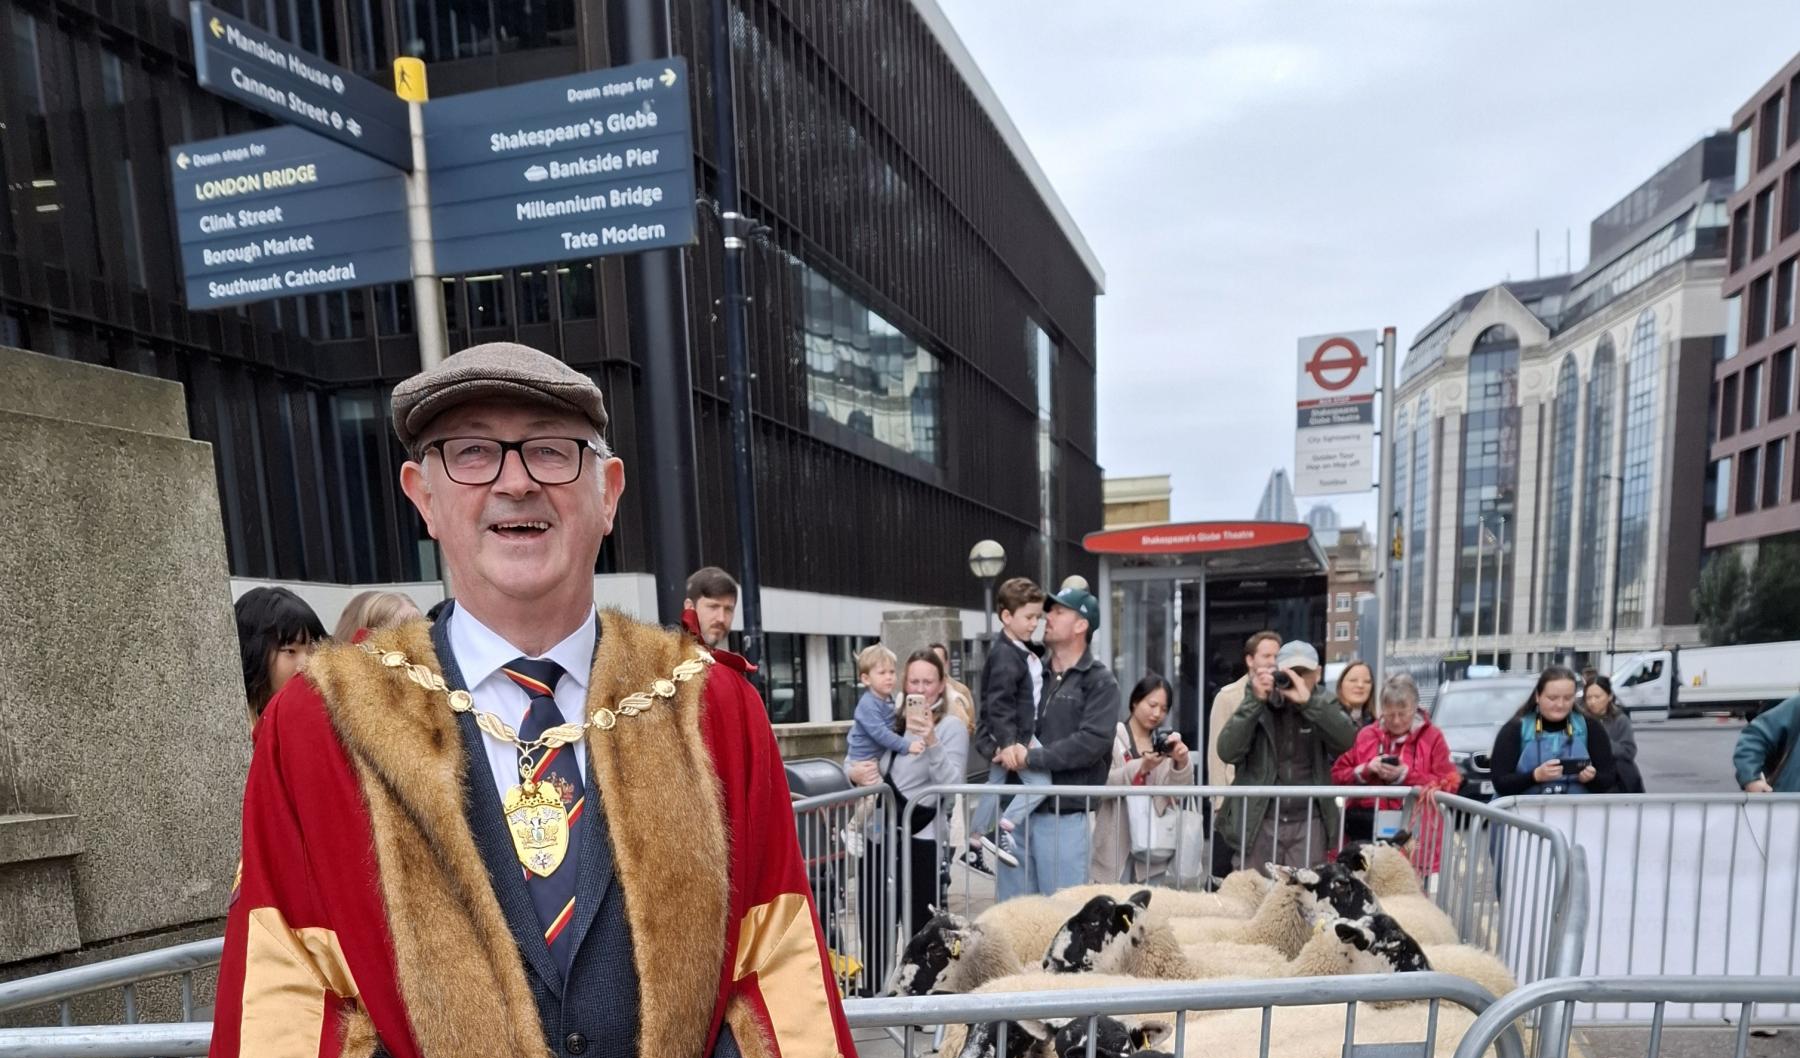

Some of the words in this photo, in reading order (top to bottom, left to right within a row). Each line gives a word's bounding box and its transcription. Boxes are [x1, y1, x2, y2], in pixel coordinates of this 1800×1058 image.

[226, 24, 288, 69] Mansion
[288, 54, 332, 90] House
[231, 66, 287, 106] Cannon
[288, 91, 330, 126] Street
[567, 87, 600, 103] Down
[602, 80, 635, 97] steps
[636, 76, 655, 91] for
[490, 117, 604, 152] Shakespeare's
[607, 110, 658, 134] Globe
[192, 153, 222, 168] Down
[222, 147, 250, 163] steps
[250, 143, 266, 157] for
[549, 152, 623, 180] Bankside
[626, 148, 660, 168] Pier
[195, 173, 261, 201] LONDON
[262, 164, 318, 189] BRIDGE
[200, 212, 238, 233] Clink
[238, 205, 284, 228] Street
[516, 194, 607, 222] Millennium
[609, 185, 663, 208] Bridge
[203, 242, 262, 266] Borough
[263, 234, 315, 257] Market
[561, 231, 599, 251] Tate
[602, 223, 666, 246] Modern
[208, 273, 283, 299] Southwark
[284, 262, 357, 288] Cathedral
[1141, 534, 1197, 546] Shakespeare's
[1197, 532, 1222, 542] Globe
[1223, 529, 1255, 540] Theatre
